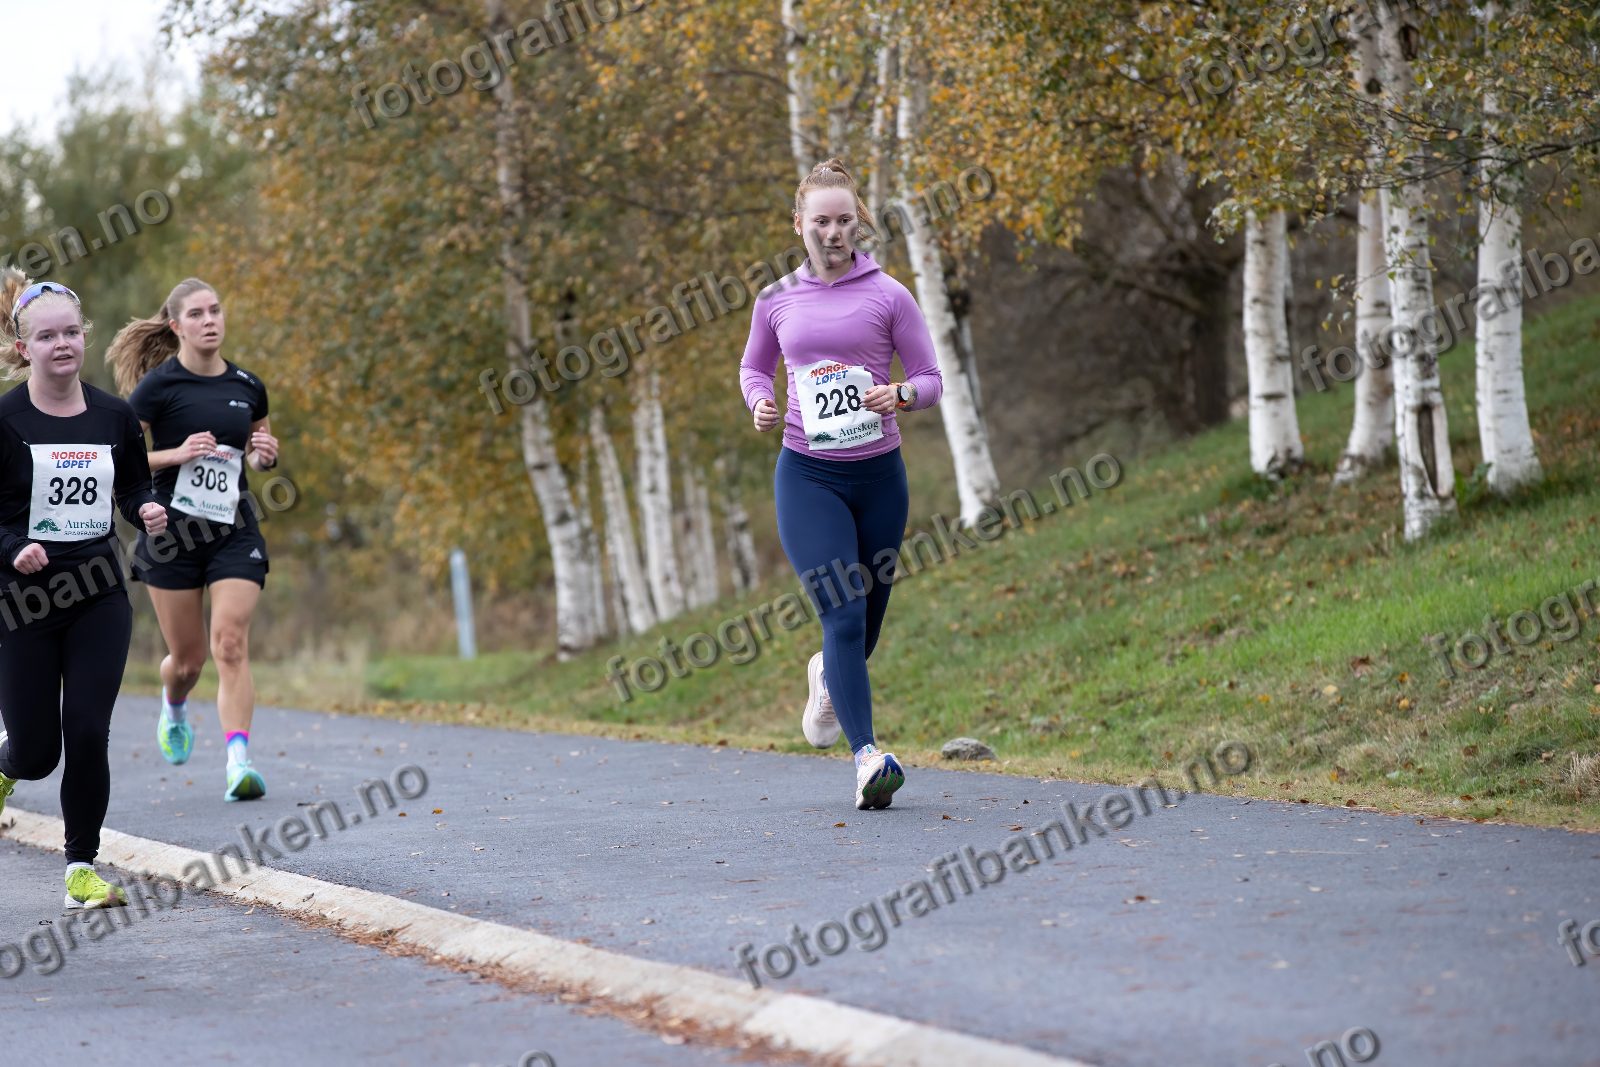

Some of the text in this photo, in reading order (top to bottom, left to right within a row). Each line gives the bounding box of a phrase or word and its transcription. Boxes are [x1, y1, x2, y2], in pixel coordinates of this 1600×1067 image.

[808, 363, 852, 378] NORGE
[816, 369, 848, 385] LØPET
[816, 385, 861, 419] 228
[839, 421, 879, 437] Aurskog
[51, 451, 98, 460] NORGES
[56, 460, 91, 468] LØPET
[191, 466, 228, 492] 308
[48, 476, 98, 505] 328
[64, 518, 108, 532] Aurskog
